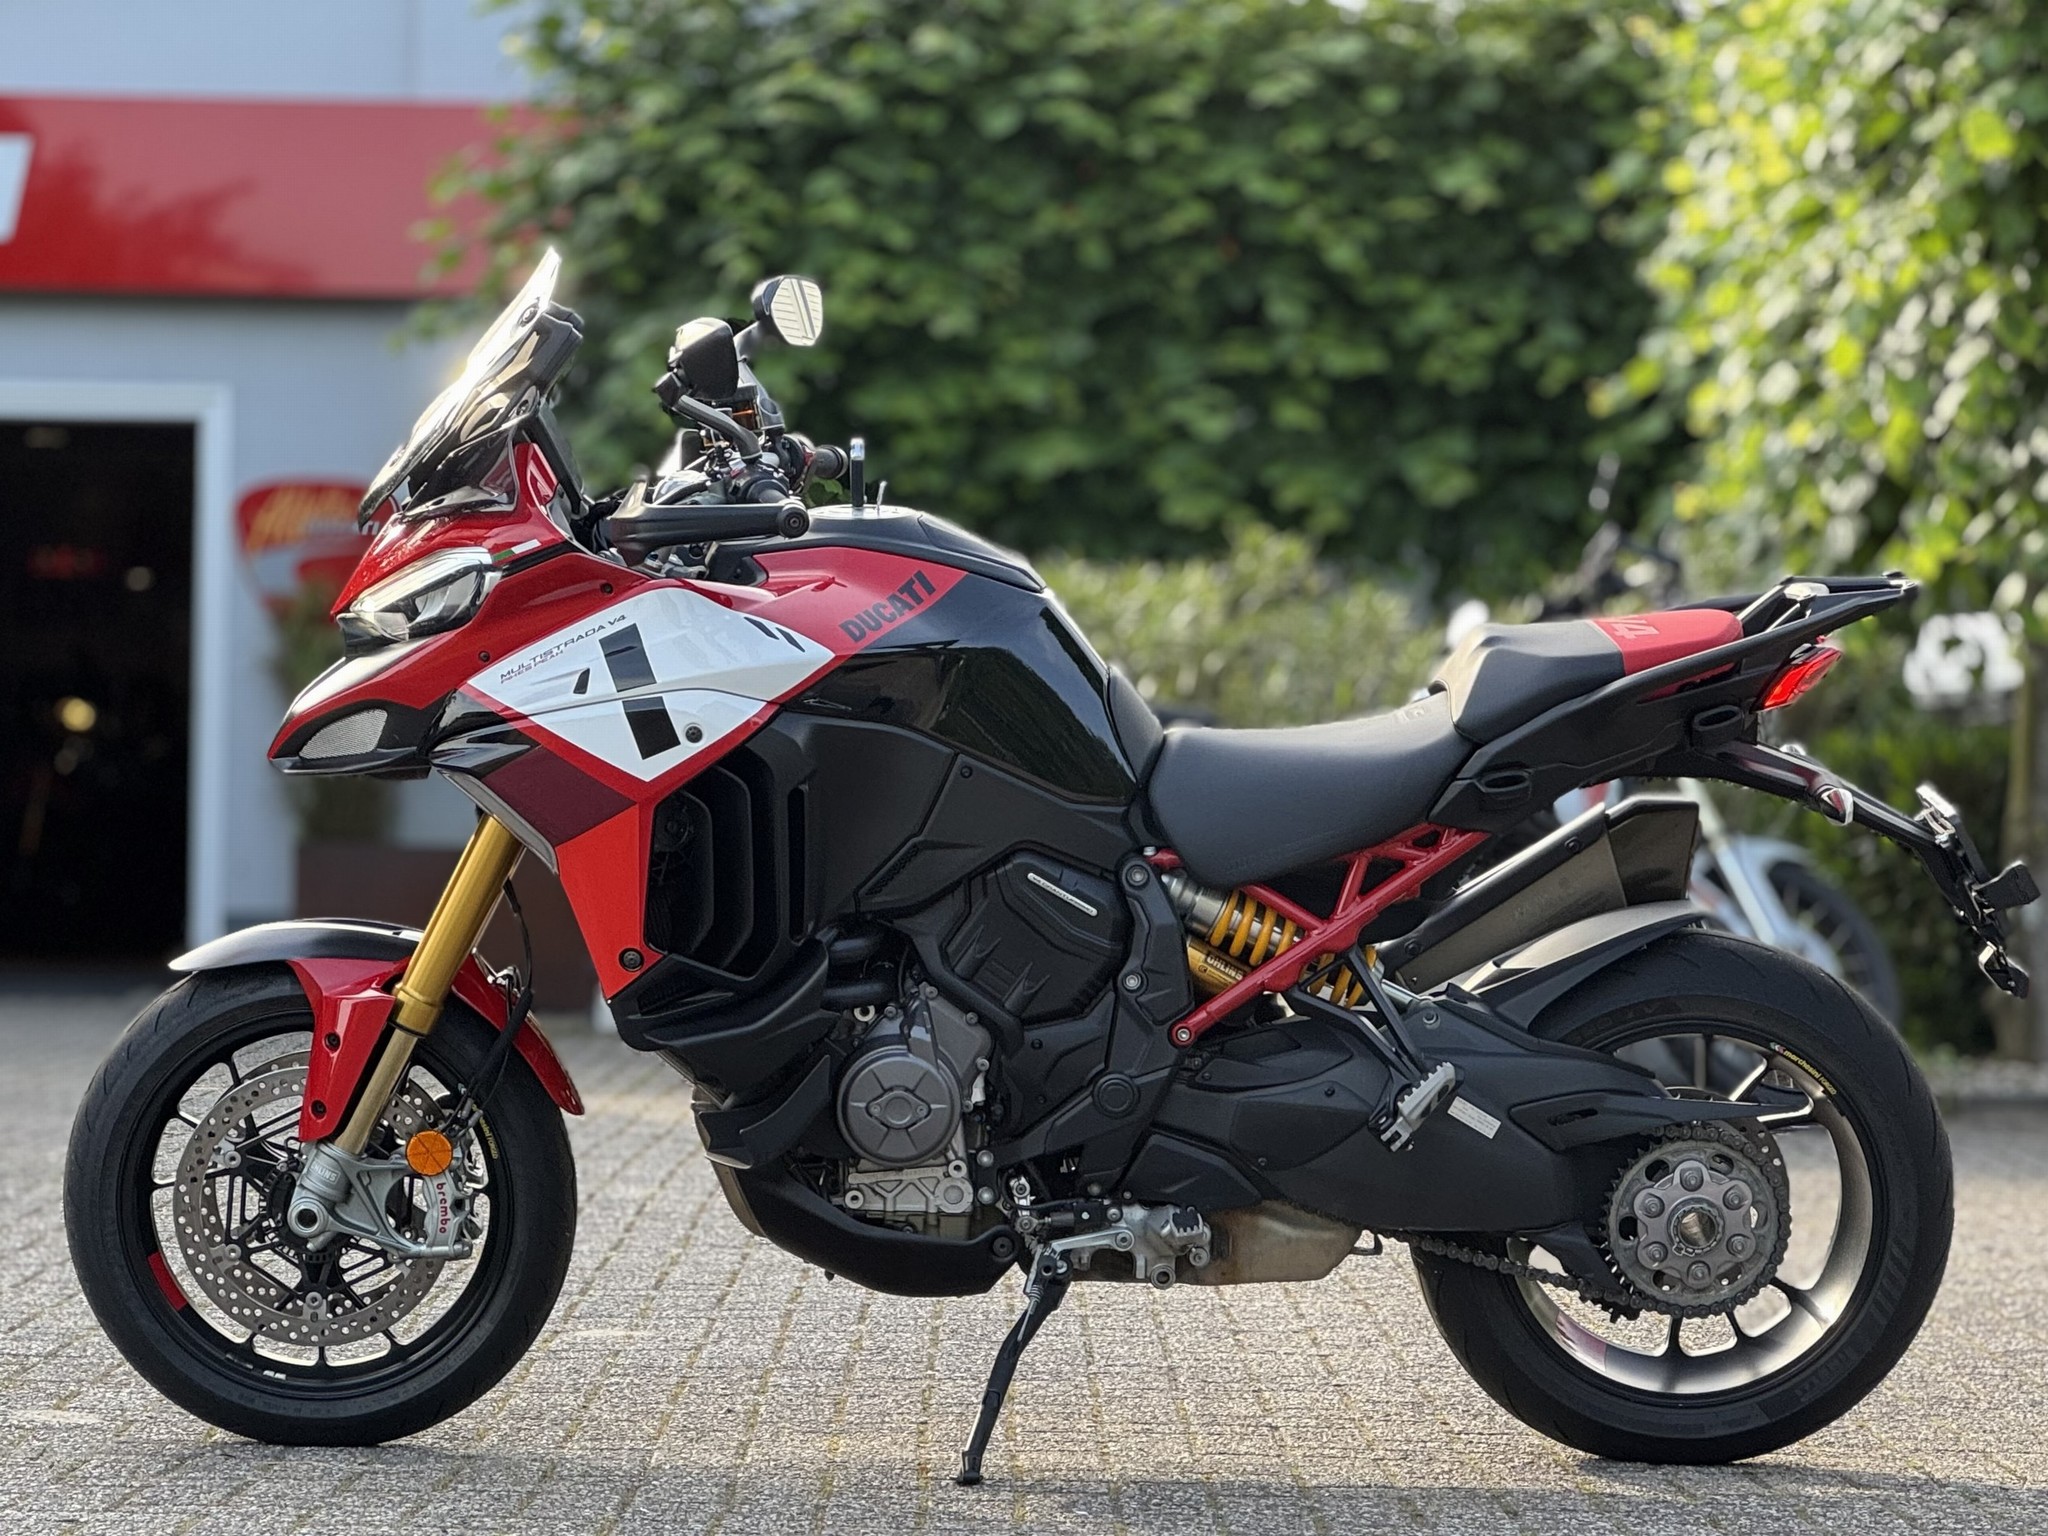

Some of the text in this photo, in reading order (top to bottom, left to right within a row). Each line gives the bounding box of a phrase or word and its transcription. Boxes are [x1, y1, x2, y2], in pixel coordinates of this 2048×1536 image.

[839, 570, 937, 643] DUCATI
[501, 614, 628, 680] MULTISTRADA V4
[436, 1182, 450, 1234] brembo
